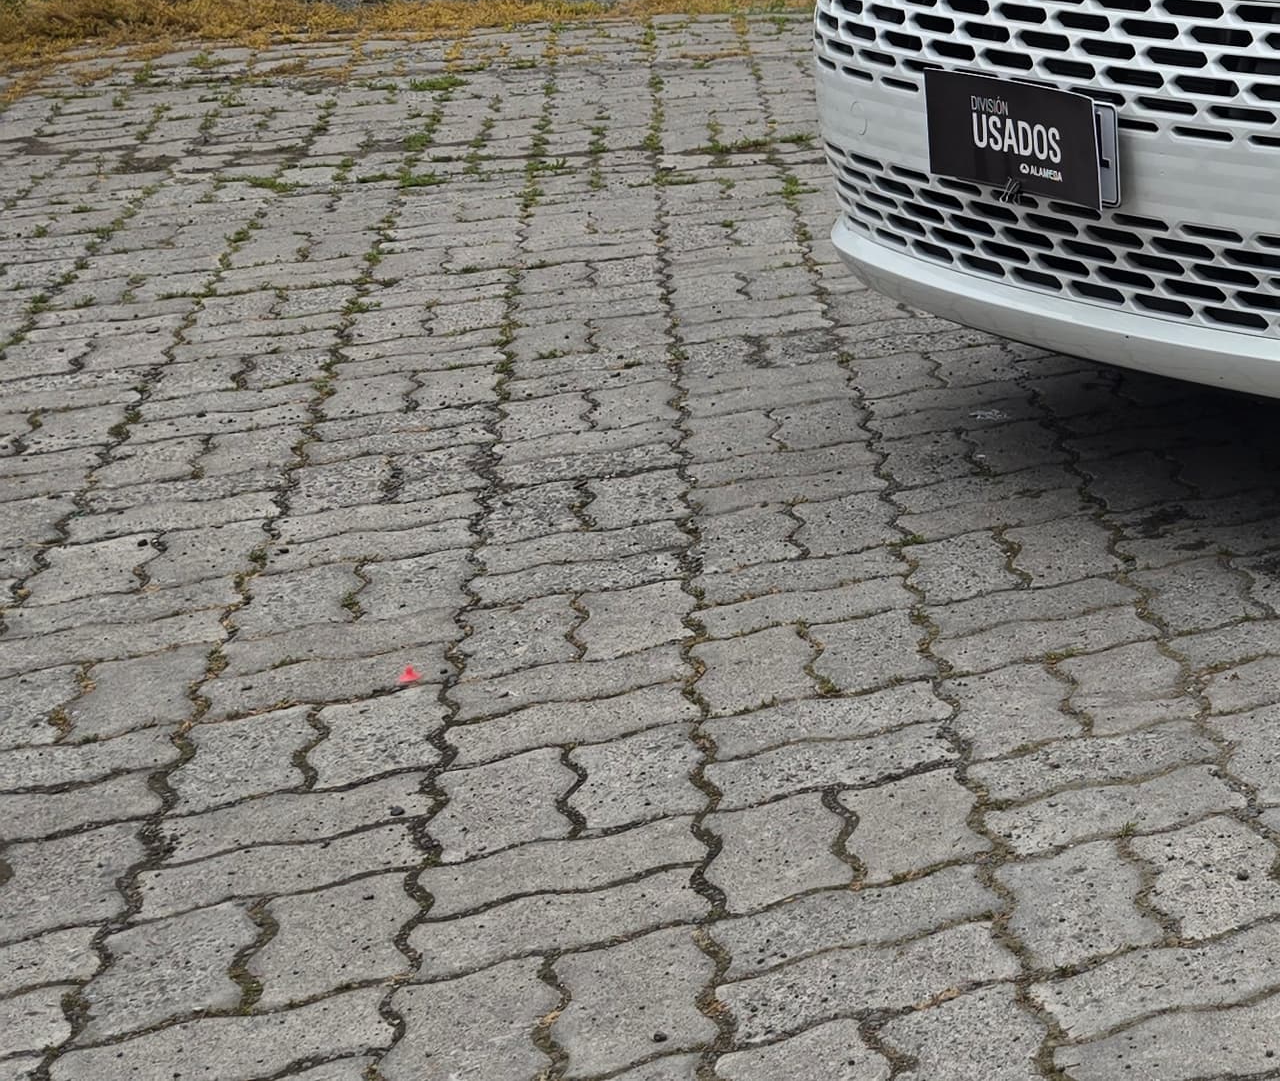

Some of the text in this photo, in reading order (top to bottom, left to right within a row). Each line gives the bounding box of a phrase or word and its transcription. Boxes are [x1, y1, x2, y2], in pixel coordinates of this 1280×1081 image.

[970, 95, 1009, 117] DIVISIÓN
[972, 112, 1062, 164] USADOS
[1029, 164, 1063, 183] ALAMEDA
